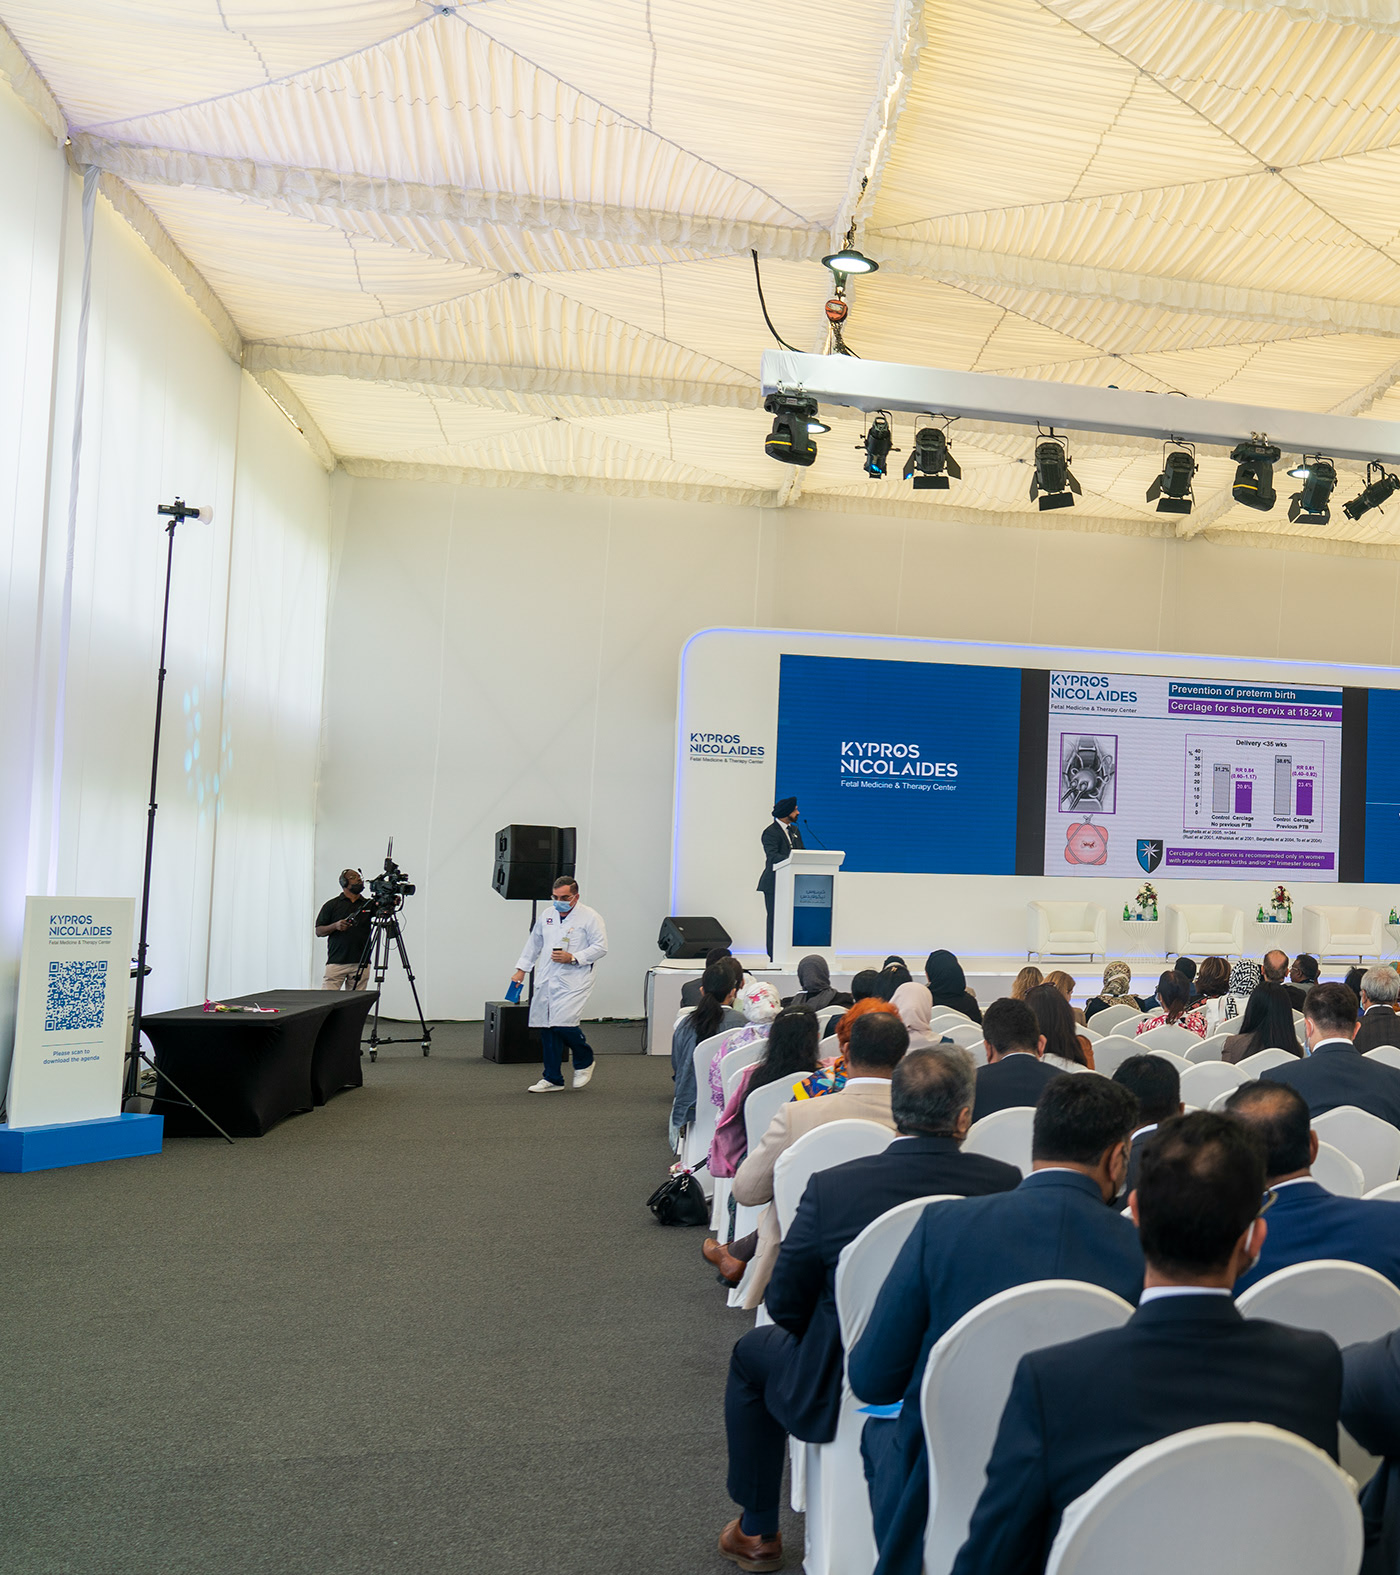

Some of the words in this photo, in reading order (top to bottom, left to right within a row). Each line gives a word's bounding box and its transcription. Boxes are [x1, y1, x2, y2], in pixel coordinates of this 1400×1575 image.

[1052, 674, 1109, 688] KYPROS
[1051, 688, 1138, 702] NICOLAIDES
[1172, 685, 1222, 696] Prevention
[1225, 686, 1234, 696] of
[1237, 688, 1273, 698] preterm
[1275, 690, 1296, 700] birth
[1171, 702, 1212, 712] Cerclage
[1215, 703, 1228, 712] for
[1231, 704, 1255, 714] short
[1257, 707, 1285, 716] cervix
[1288, 708, 1296, 716] at
[1299, 709, 1322, 718] 18-24
[690, 733, 740, 744] KYPROS
[690, 744, 765, 755] NICOLAIDES
[841, 742, 920, 758] KYPROS
[841, 759, 958, 777] NICOLAIDES
[902, 782, 931, 791] Therapy
[50, 915, 92, 924] KYPROS
[49, 926, 112, 936] NICOLAIDES
